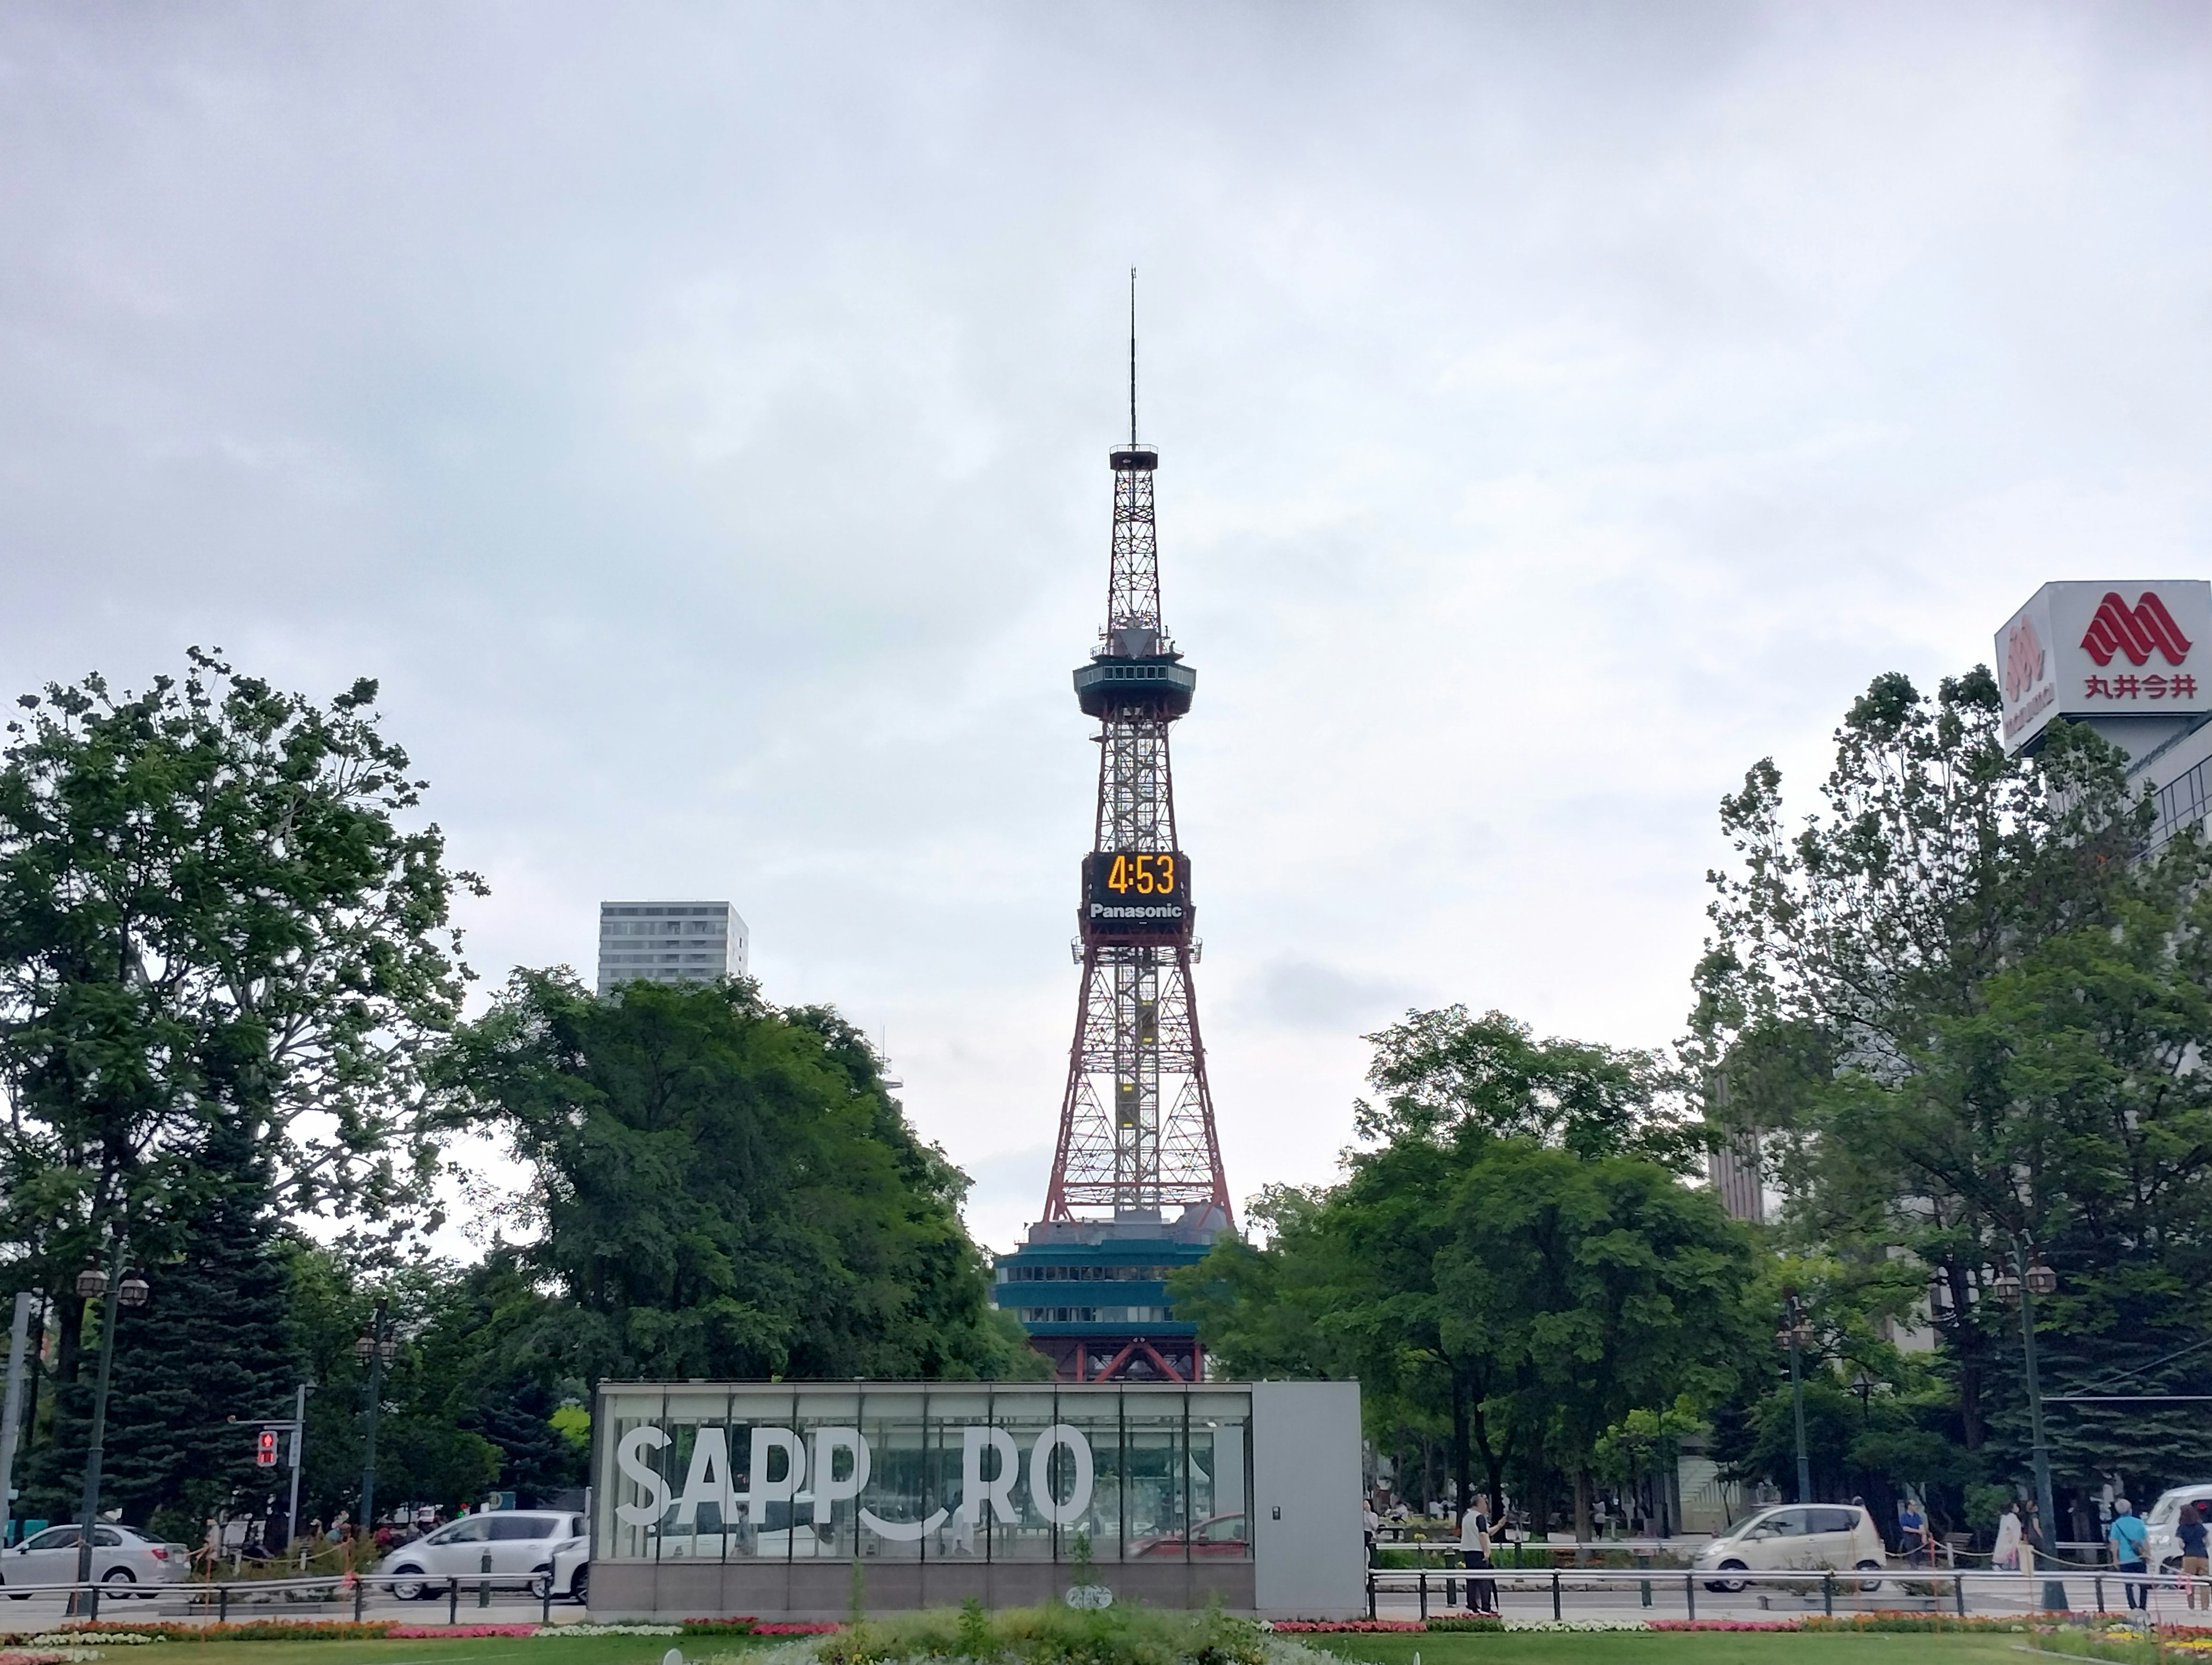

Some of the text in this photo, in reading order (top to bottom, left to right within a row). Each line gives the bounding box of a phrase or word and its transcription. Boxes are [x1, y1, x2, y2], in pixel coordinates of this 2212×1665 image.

[2084, 674, 2198, 699] 丸井今井
[1108, 855, 1174, 894] 4:53
[1090, 903, 1183, 918] Panasonic
